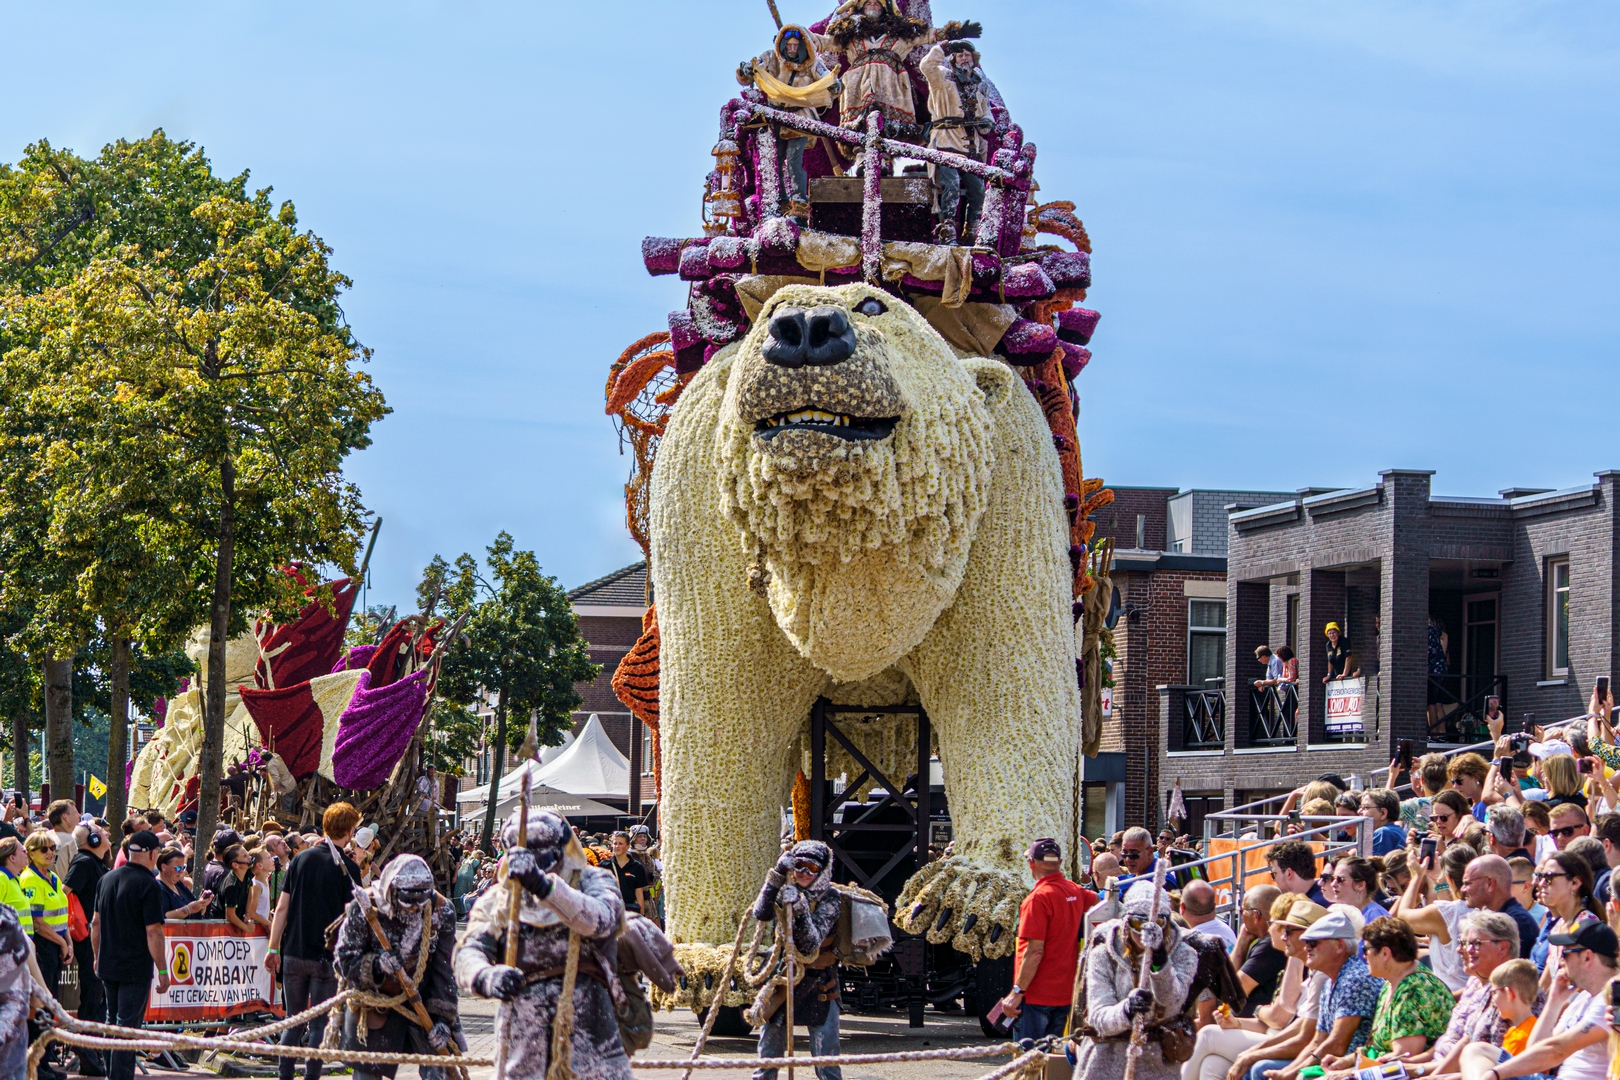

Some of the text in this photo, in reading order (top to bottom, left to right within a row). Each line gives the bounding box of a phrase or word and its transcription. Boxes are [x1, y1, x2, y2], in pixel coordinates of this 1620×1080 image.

[197, 940, 251, 961] OMROEP
[195, 965, 258, 985] BRABANT
[169, 988, 260, 1003] HET GEVOEL VAN HIER
